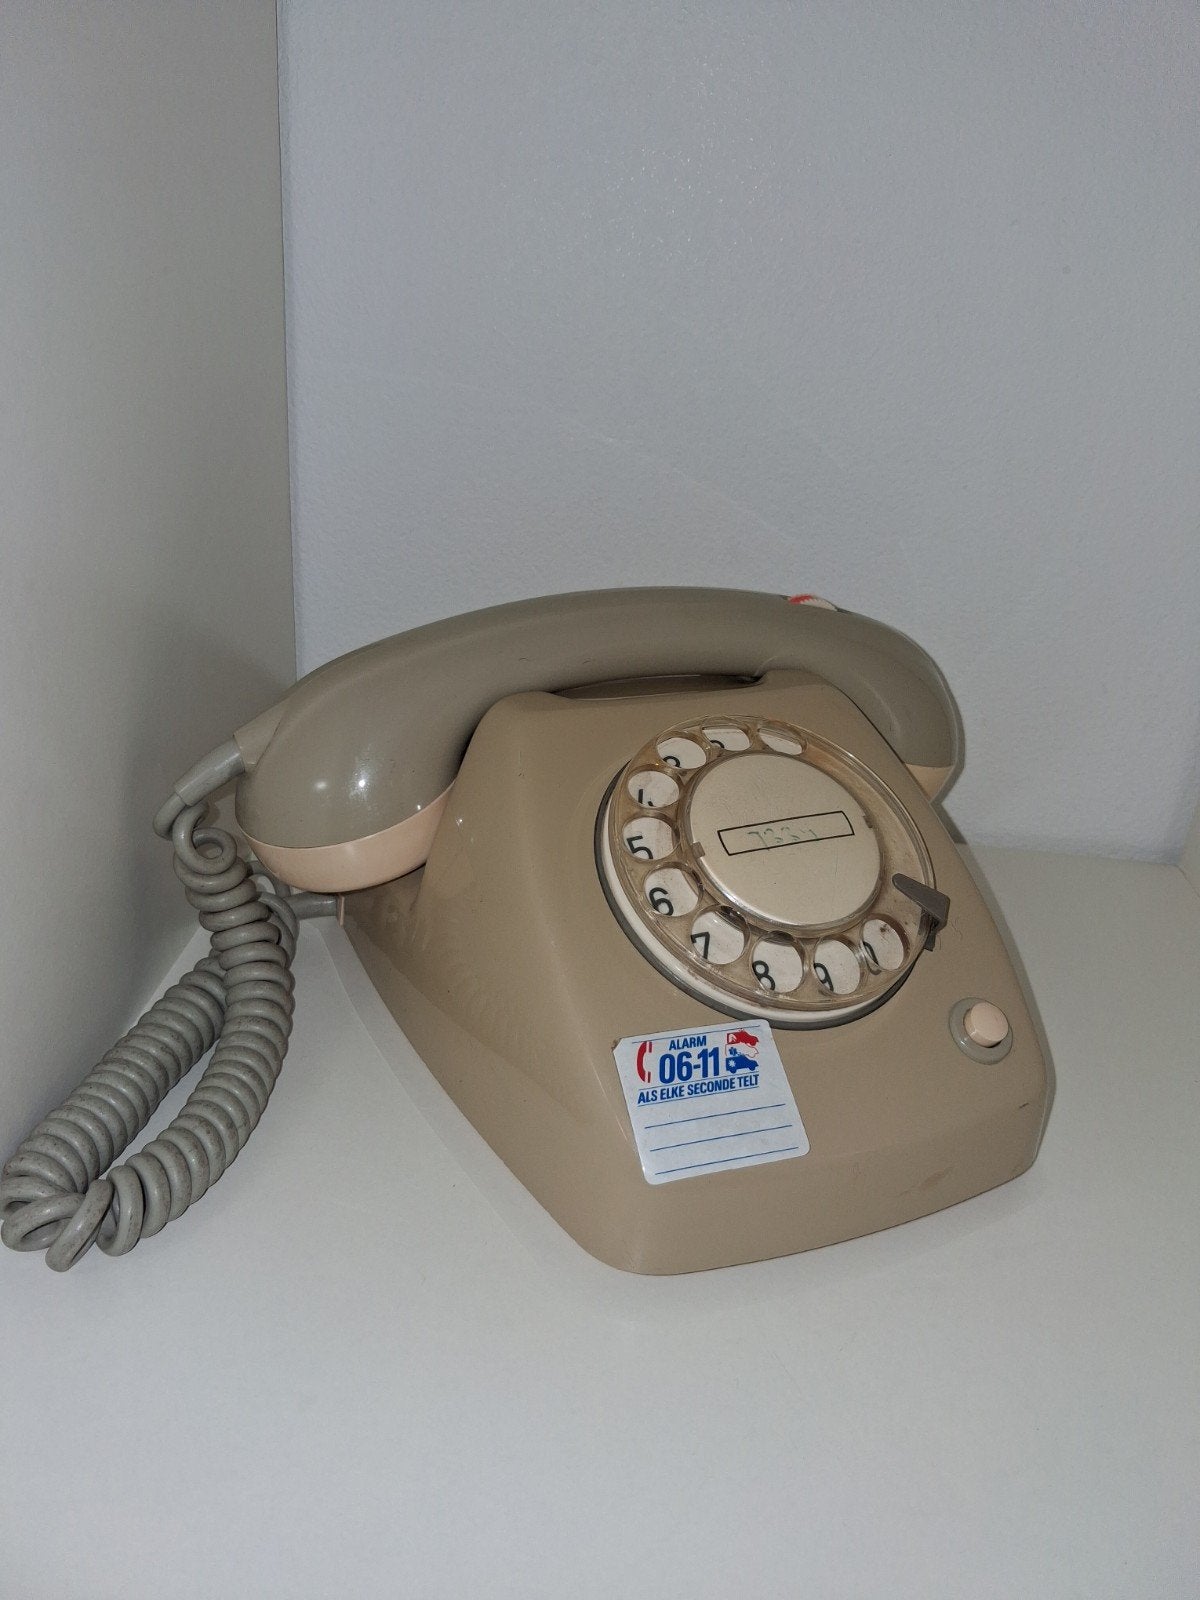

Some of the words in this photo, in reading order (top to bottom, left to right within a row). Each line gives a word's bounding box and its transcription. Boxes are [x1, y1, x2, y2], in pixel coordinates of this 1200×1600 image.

[649, 887, 674, 916] 6
[690, 931, 711, 960] 7
[752, 960, 776, 991] 8
[813, 962, 835, 993] 9
[669, 1036, 706, 1050] ALARM
[659, 1047, 719, 1084] 06-11
[638, 1090, 657, 1104] ALS
[660, 1086, 684, 1100] ELKE
[687, 1078, 735, 1096] SECONDE
[737, 1074, 759, 1088] TELT
